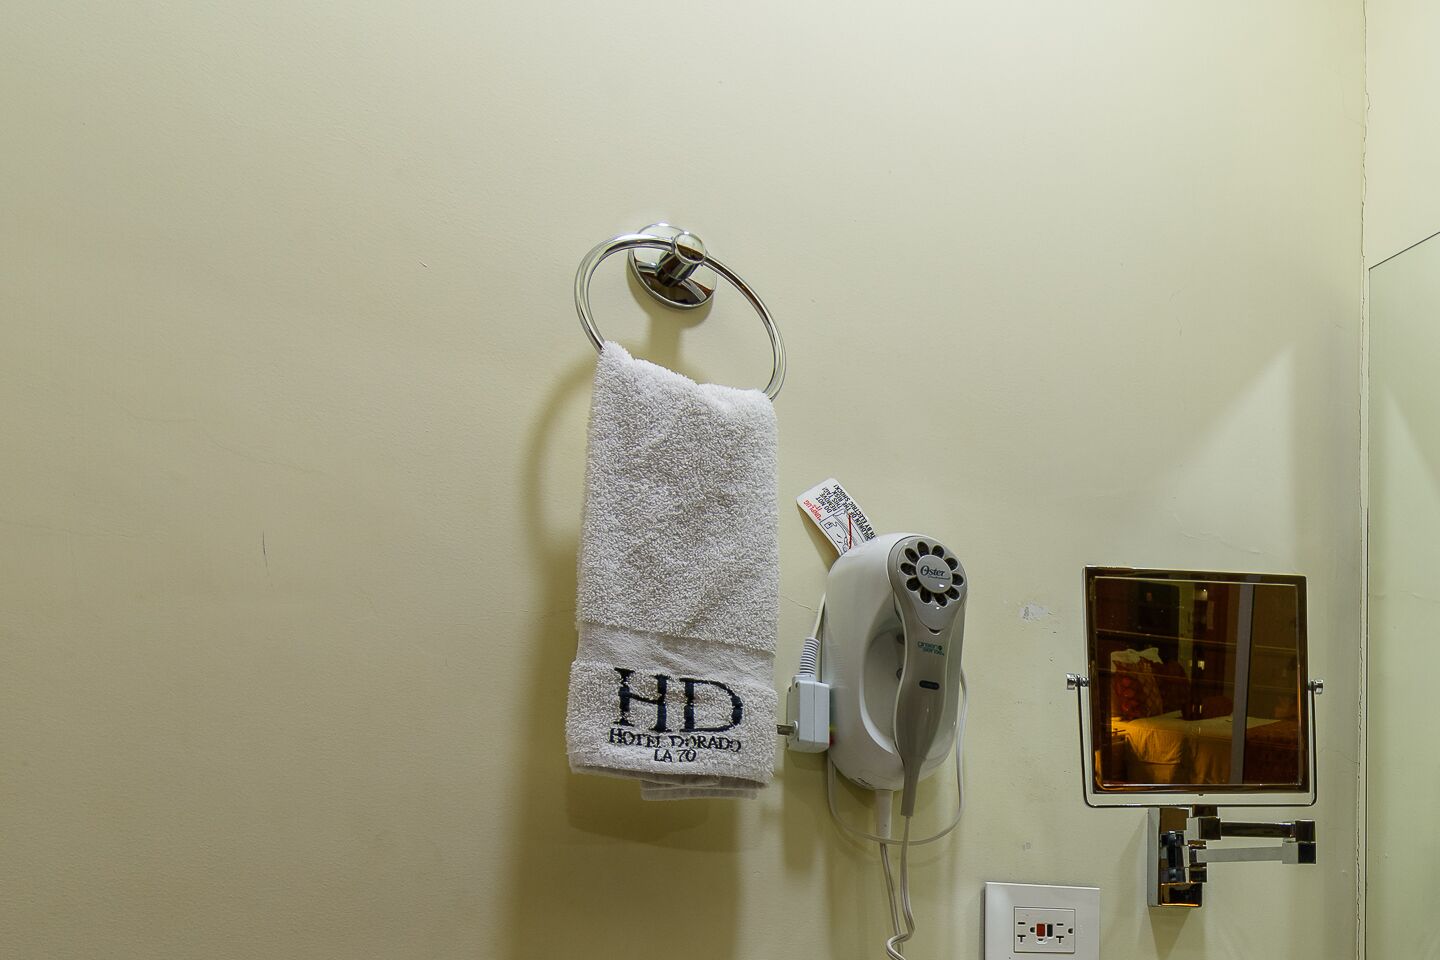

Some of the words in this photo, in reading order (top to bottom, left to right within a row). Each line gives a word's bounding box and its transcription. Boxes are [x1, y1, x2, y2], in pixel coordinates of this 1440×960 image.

[832, 489, 844, 503] RISK
[833, 484, 851, 502] SHOCK!
[815, 496, 826, 507] NOT
[819, 492, 838, 512] REMOVE
[832, 498, 842, 509] THIS
[842, 502, 851, 512] THE
[824, 505, 833, 513] DO
[849, 501, 868, 524] ELECTRIC
[865, 523, 873, 532] BY
[920, 565, 945, 577] Oster
[614, 667, 743, 733] HD
[609, 727, 662, 749] HOTEL
[670, 735, 742, 753] DORADO
[654, 749, 673, 762] LA
[676, 749, 697, 762] 70
